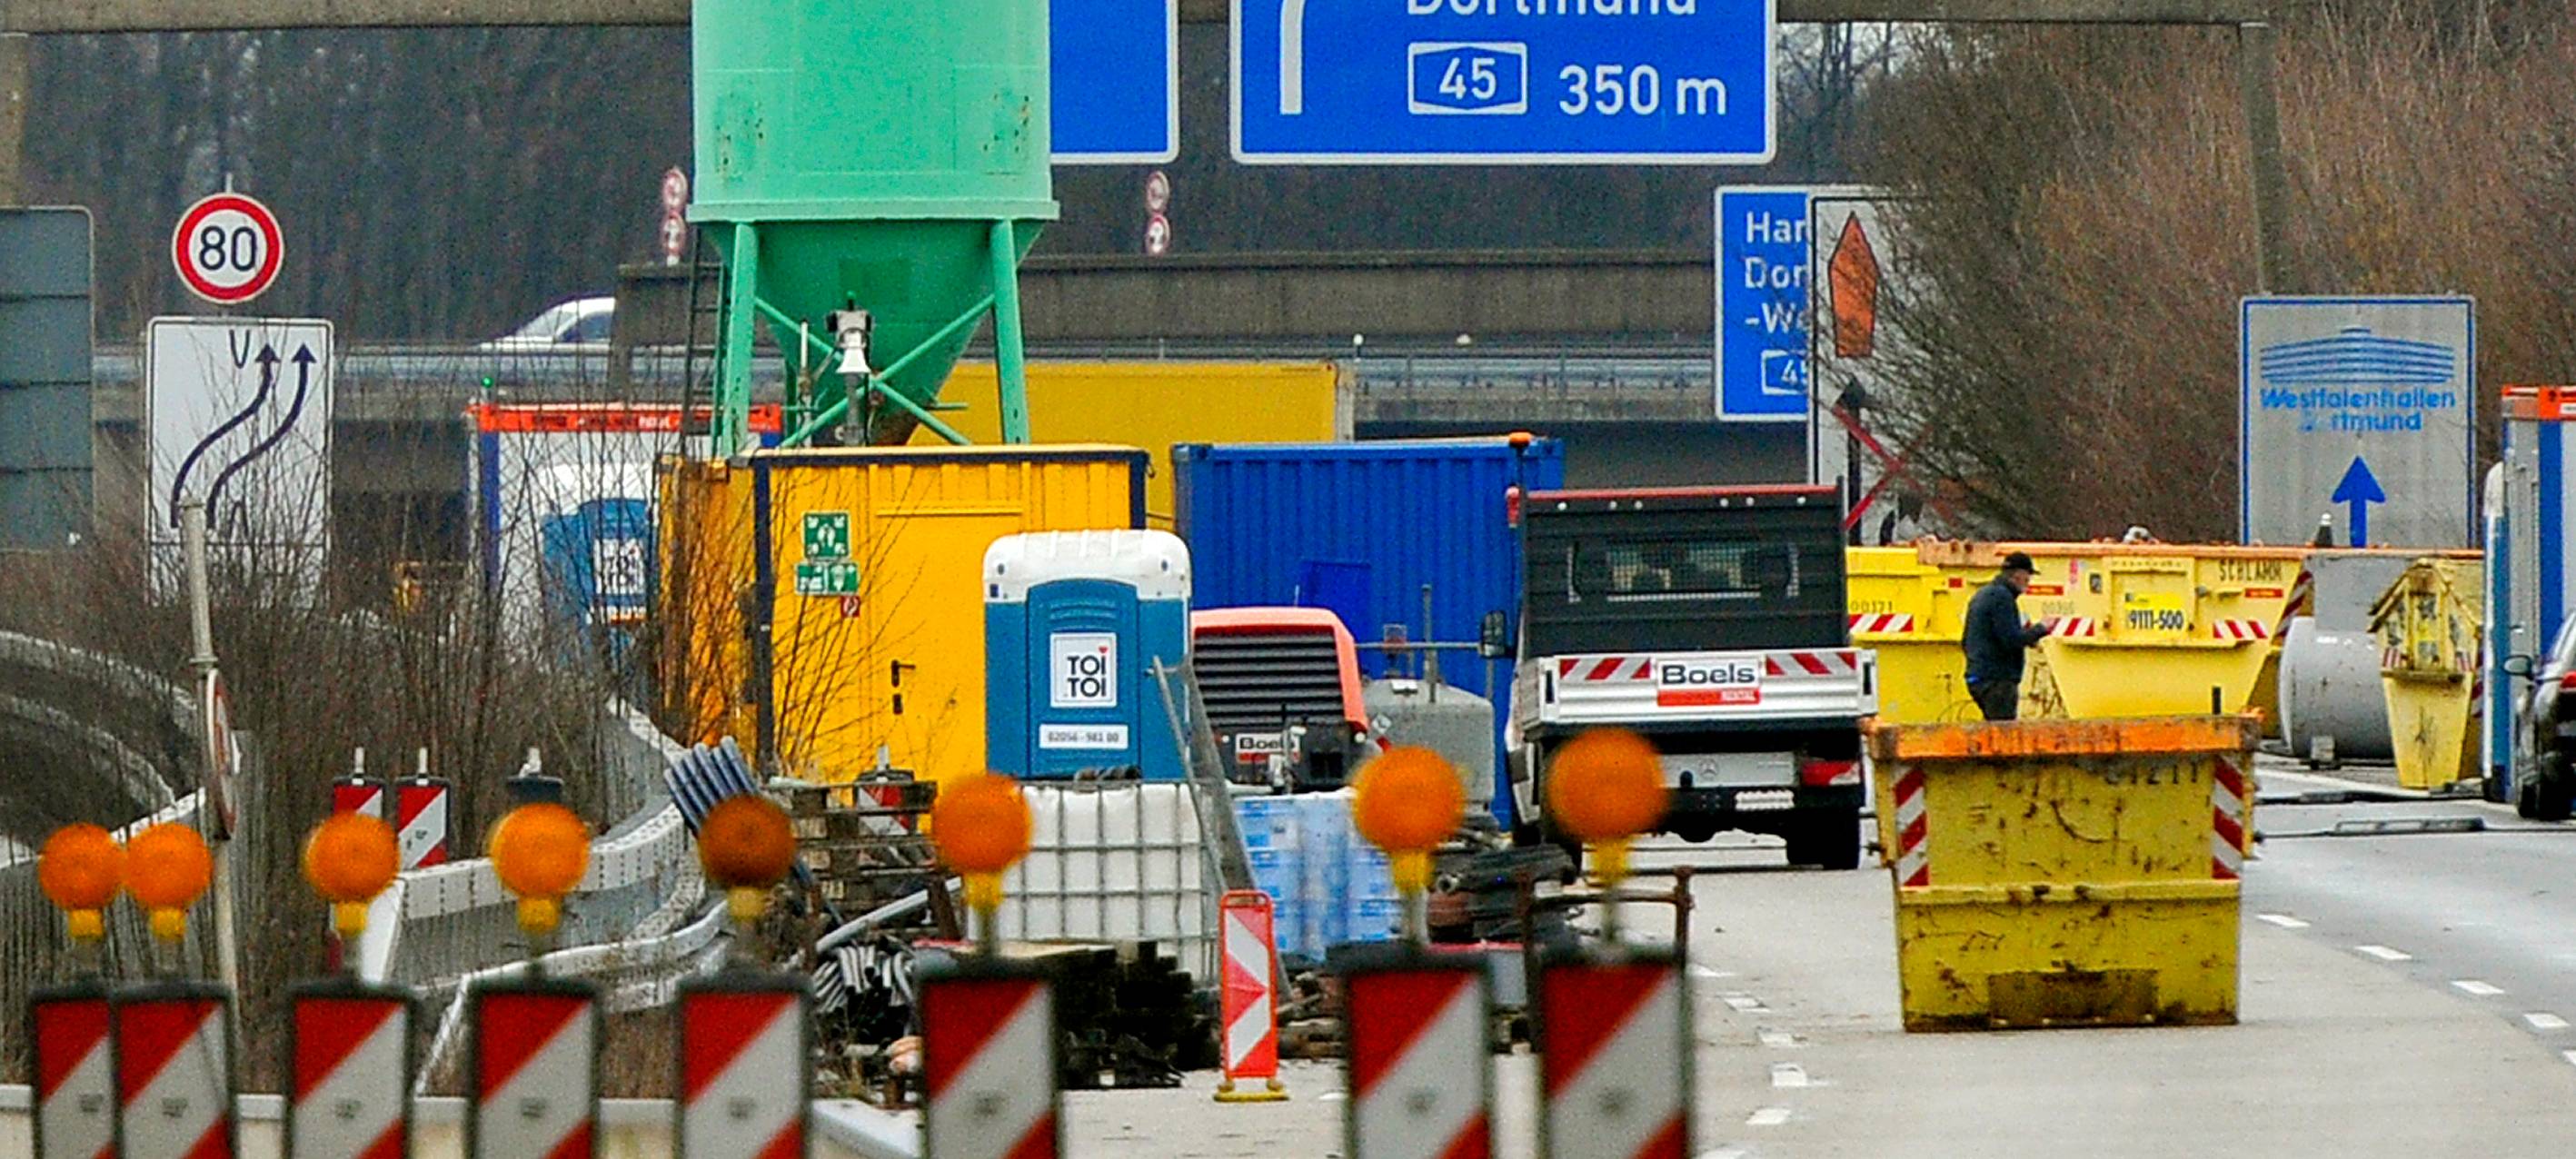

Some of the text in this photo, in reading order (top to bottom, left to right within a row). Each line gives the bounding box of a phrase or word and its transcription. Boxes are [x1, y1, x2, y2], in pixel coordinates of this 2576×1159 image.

[1438, 57, 1727, 115] 45 350 m
[199, 225, 258, 272] 80
[1067, 655, 1107, 676] TOI
[1662, 663, 1755, 684] Boels
[1067, 678, 1107, 698] TOI
